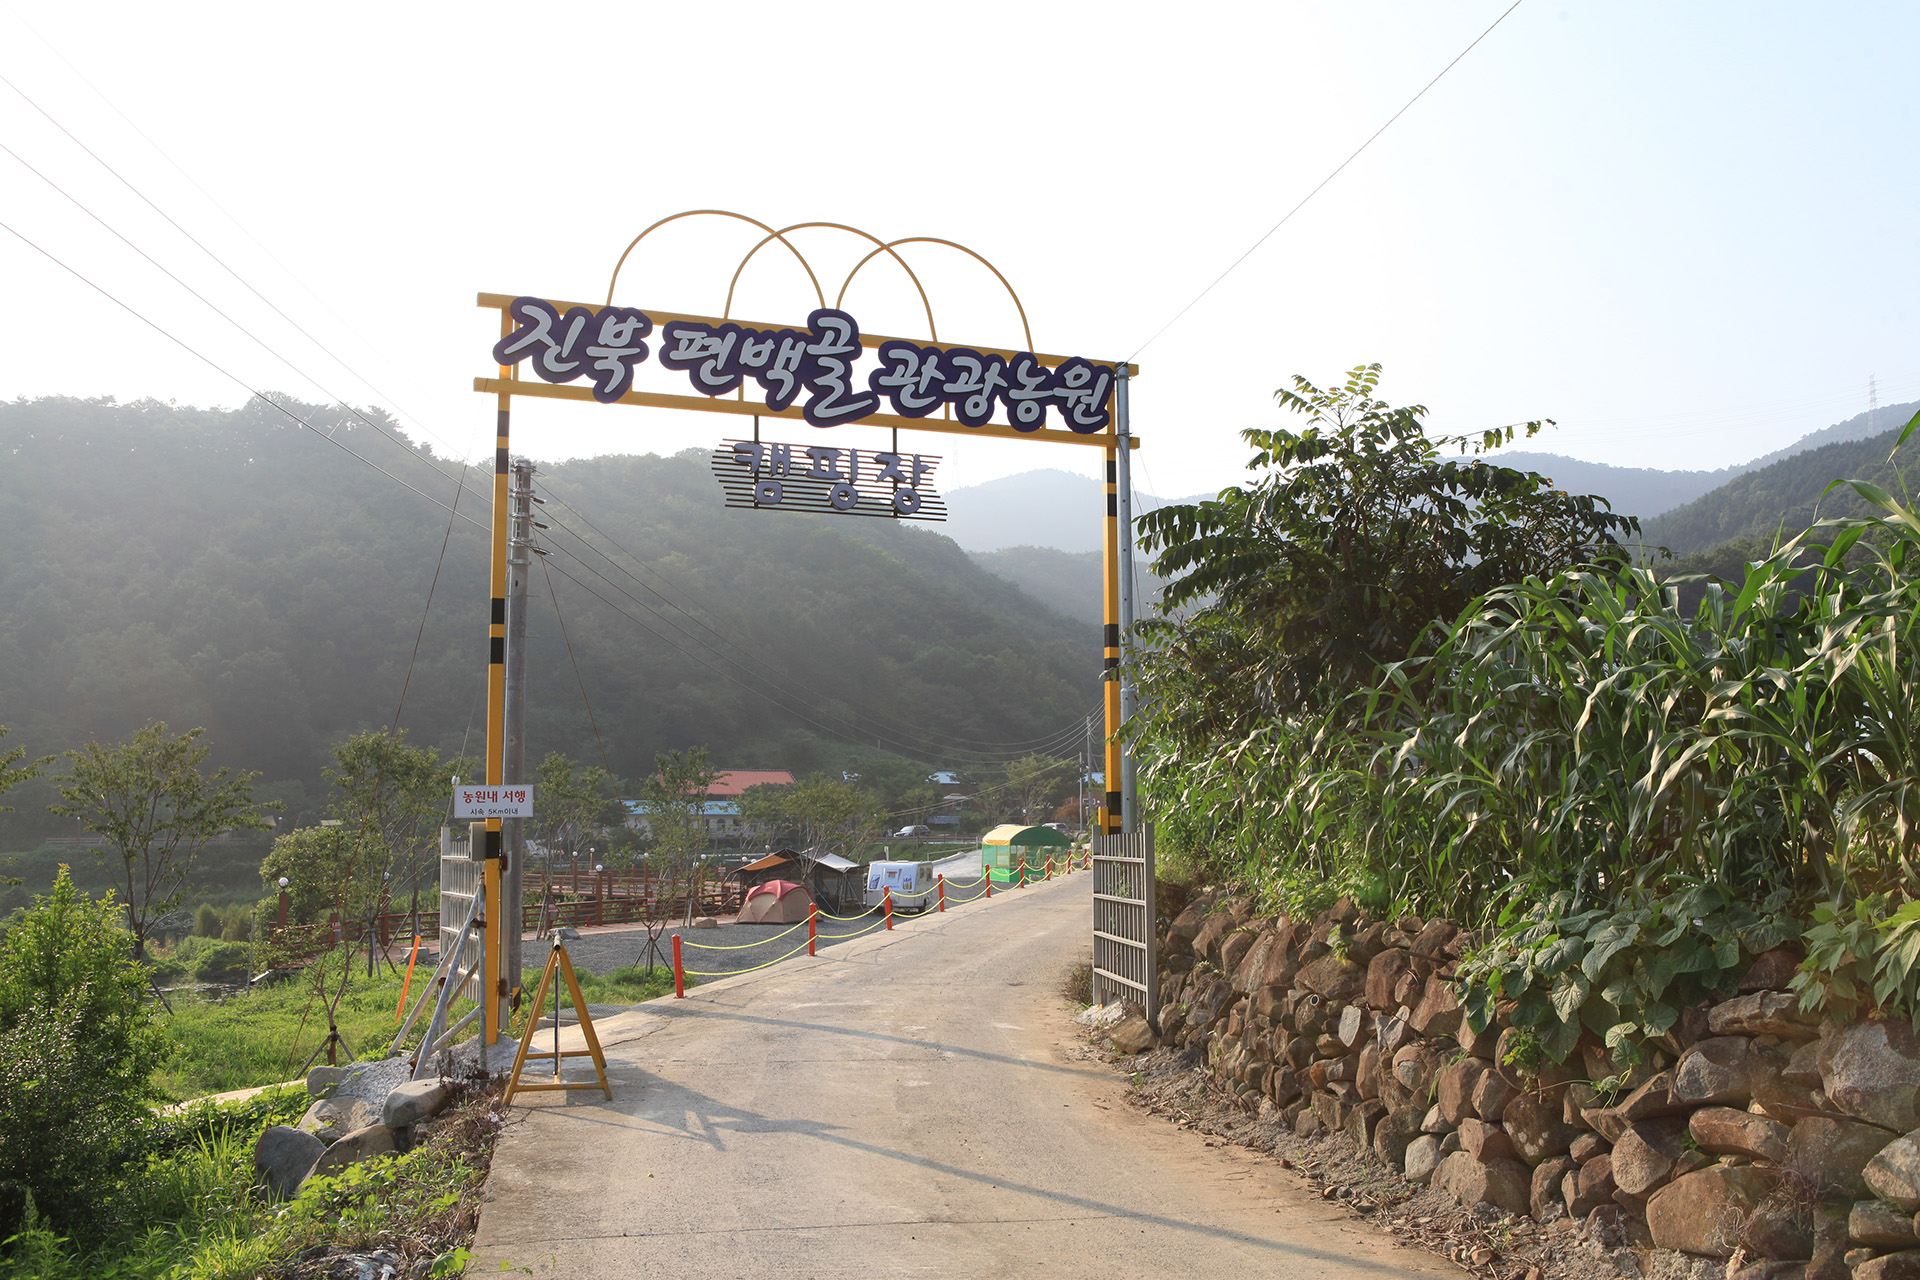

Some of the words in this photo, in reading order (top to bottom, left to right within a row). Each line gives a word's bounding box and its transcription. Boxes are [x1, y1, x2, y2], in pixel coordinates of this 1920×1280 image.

[504, 304, 643, 393] 진북
[670, 317, 873, 418] 편백골
[878, 348, 1109, 425] 관광농원
[733, 442, 930, 514] 캠핑장
[463, 790, 498, 804] 농원내
[502, 790, 526, 804] 서행
[470, 808, 485, 816] 시속
